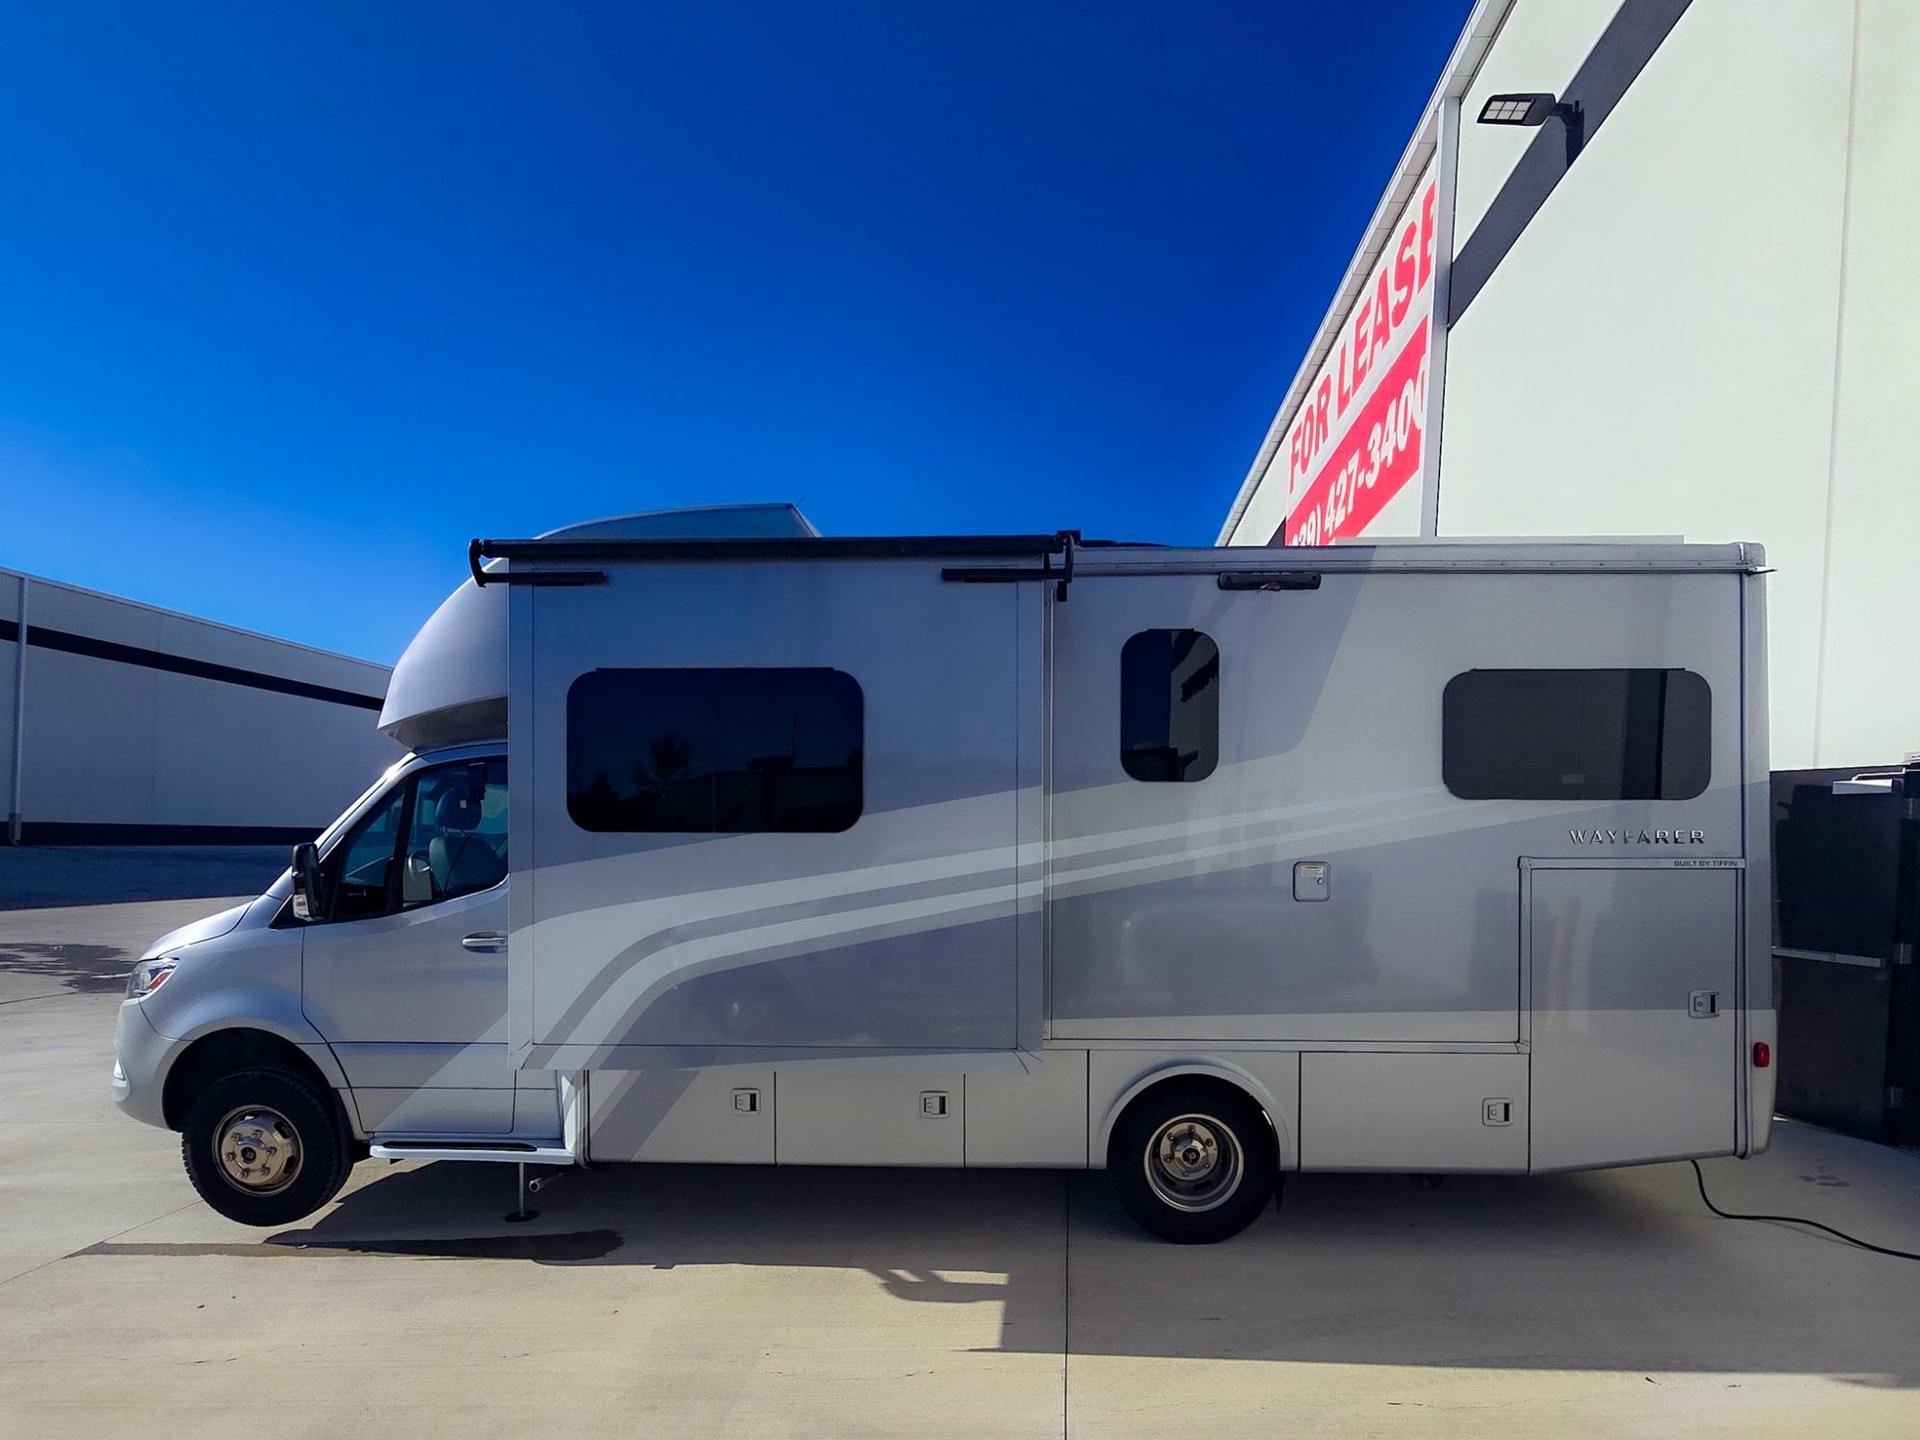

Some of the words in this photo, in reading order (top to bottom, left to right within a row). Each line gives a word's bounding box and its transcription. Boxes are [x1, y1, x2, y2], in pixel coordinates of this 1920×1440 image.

[1289, 373, 1332, 495] FOR
[1337, 180, 1436, 420] LEASE
[1568, 829, 1705, 845] WAYFARER
[1673, 860, 1697, 868] BUILT
[1699, 860, 1711, 868] BY
[1712, 860, 1738, 868] TIFFIN
